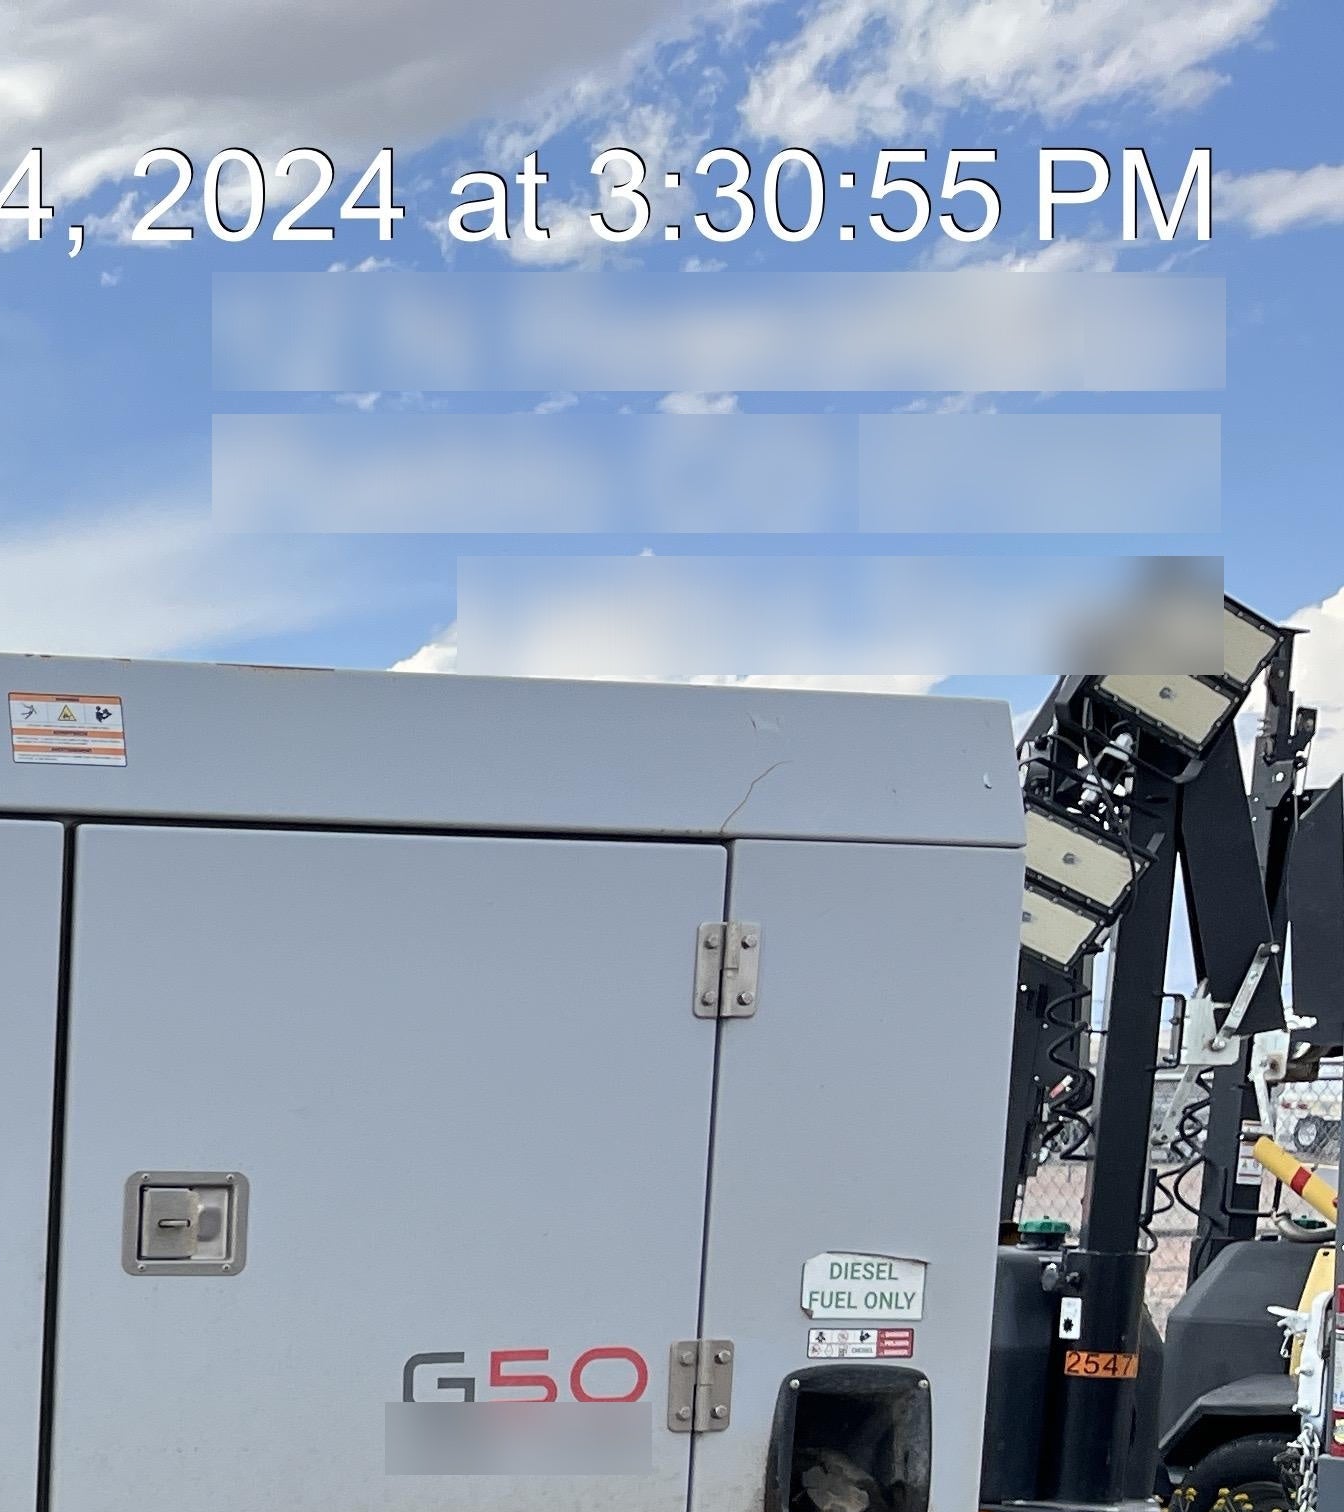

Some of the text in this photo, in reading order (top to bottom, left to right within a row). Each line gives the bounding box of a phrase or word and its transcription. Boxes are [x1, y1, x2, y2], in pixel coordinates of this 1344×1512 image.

[829, 1262, 899, 1281] DIESEL
[808, 1291, 917, 1310] FUEL ONLY
[402, 1346, 649, 1403] G50
[1066, 1351, 1134, 1377] 2547
